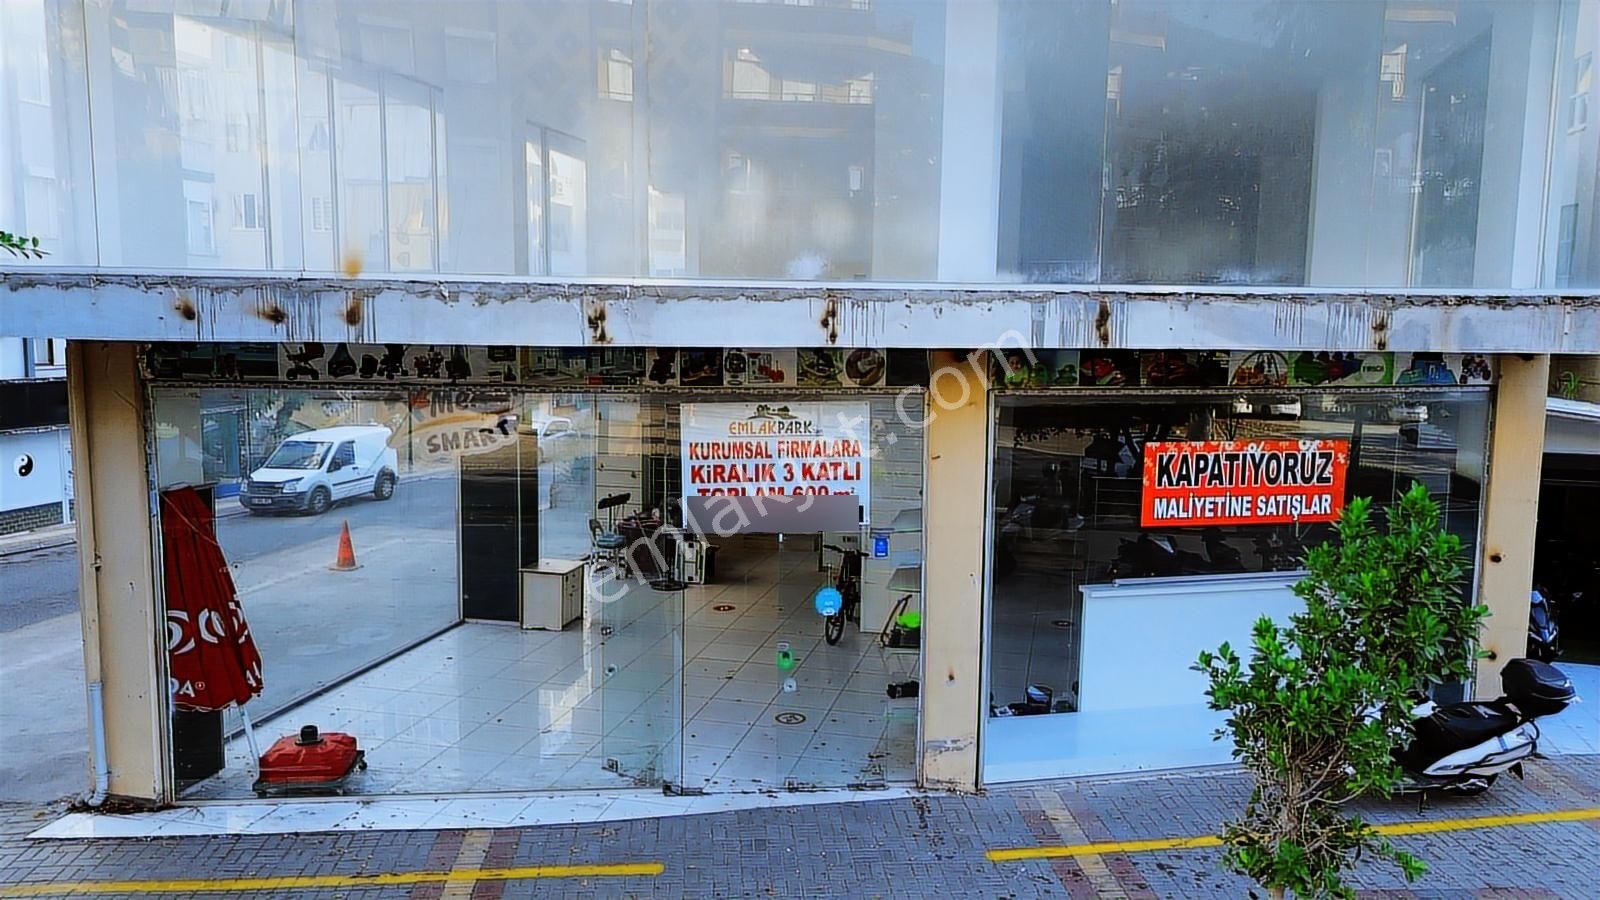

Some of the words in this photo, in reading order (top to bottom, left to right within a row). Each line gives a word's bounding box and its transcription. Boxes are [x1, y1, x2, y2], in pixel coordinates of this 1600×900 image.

[729, 420, 812, 435] EMLAKPARK
[689, 440, 772, 461] KURUMSAL
[783, 463, 794, 482] 3
[801, 462, 861, 481] KATLI
[1153, 493, 1252, 519] MALİYETİNE
[1256, 495, 1332, 521] SATIŞLAR
